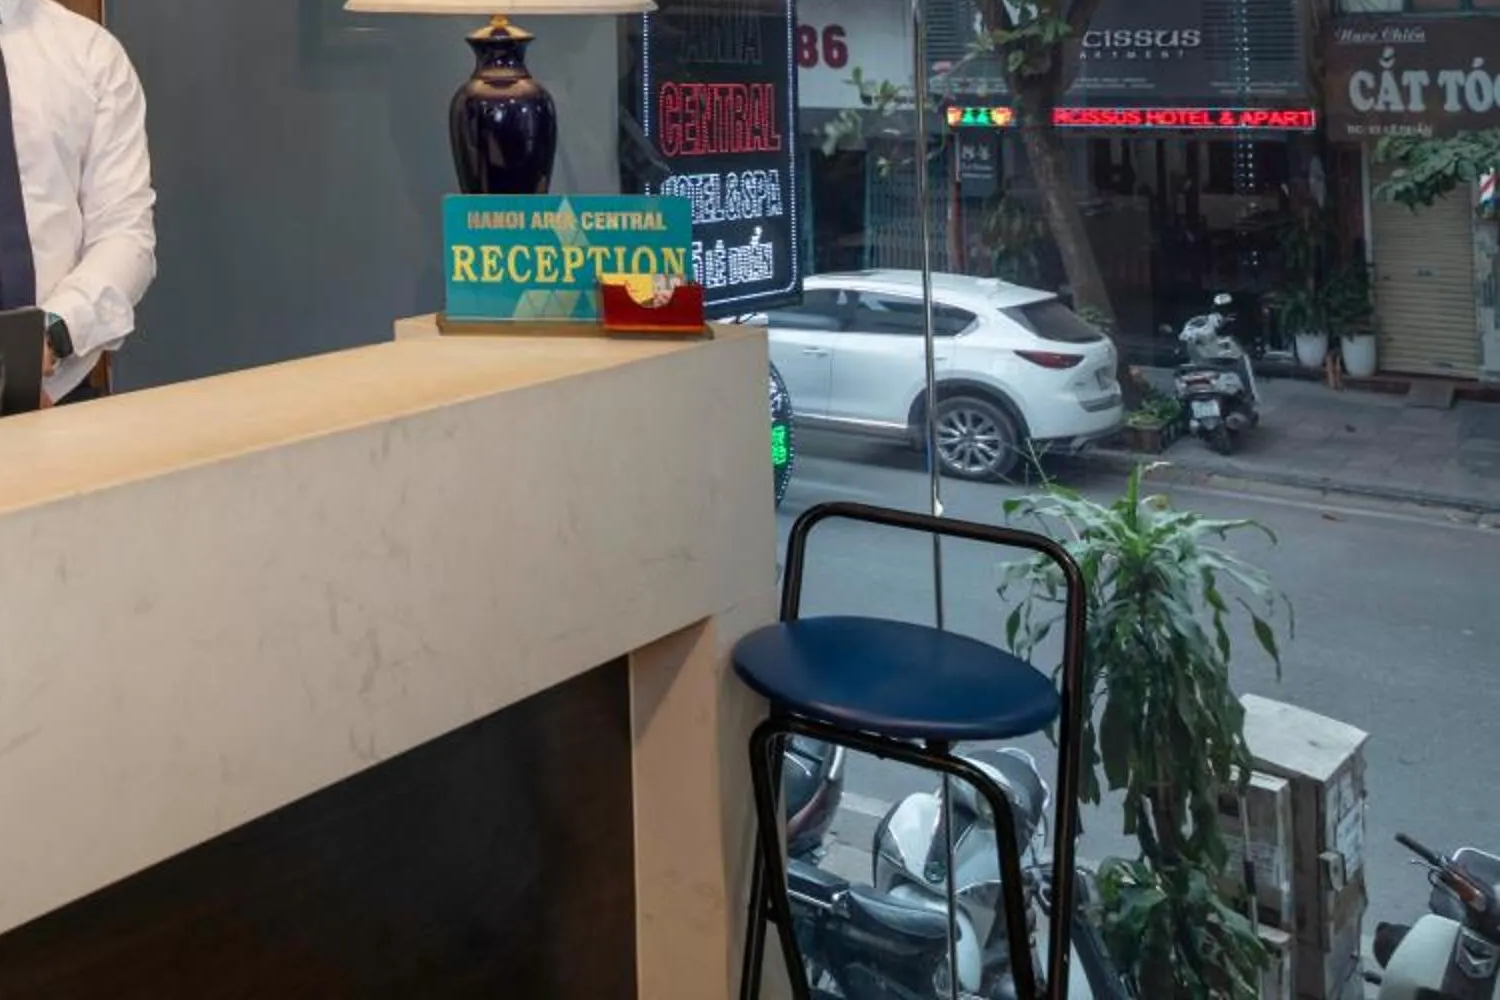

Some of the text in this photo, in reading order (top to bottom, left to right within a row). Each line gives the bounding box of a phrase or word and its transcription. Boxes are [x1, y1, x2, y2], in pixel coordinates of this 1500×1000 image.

[1349, 46, 1500, 113] CẮT TÓ
[659, 81, 782, 157] CENTRAL
[1148, 111, 1215, 126] HOTEL
[1219, 111, 1235, 126] &
[467, 211, 525, 230] HANOI
[580, 211, 667, 231] CENTRAL
[451, 244, 687, 283] RECEPTION
